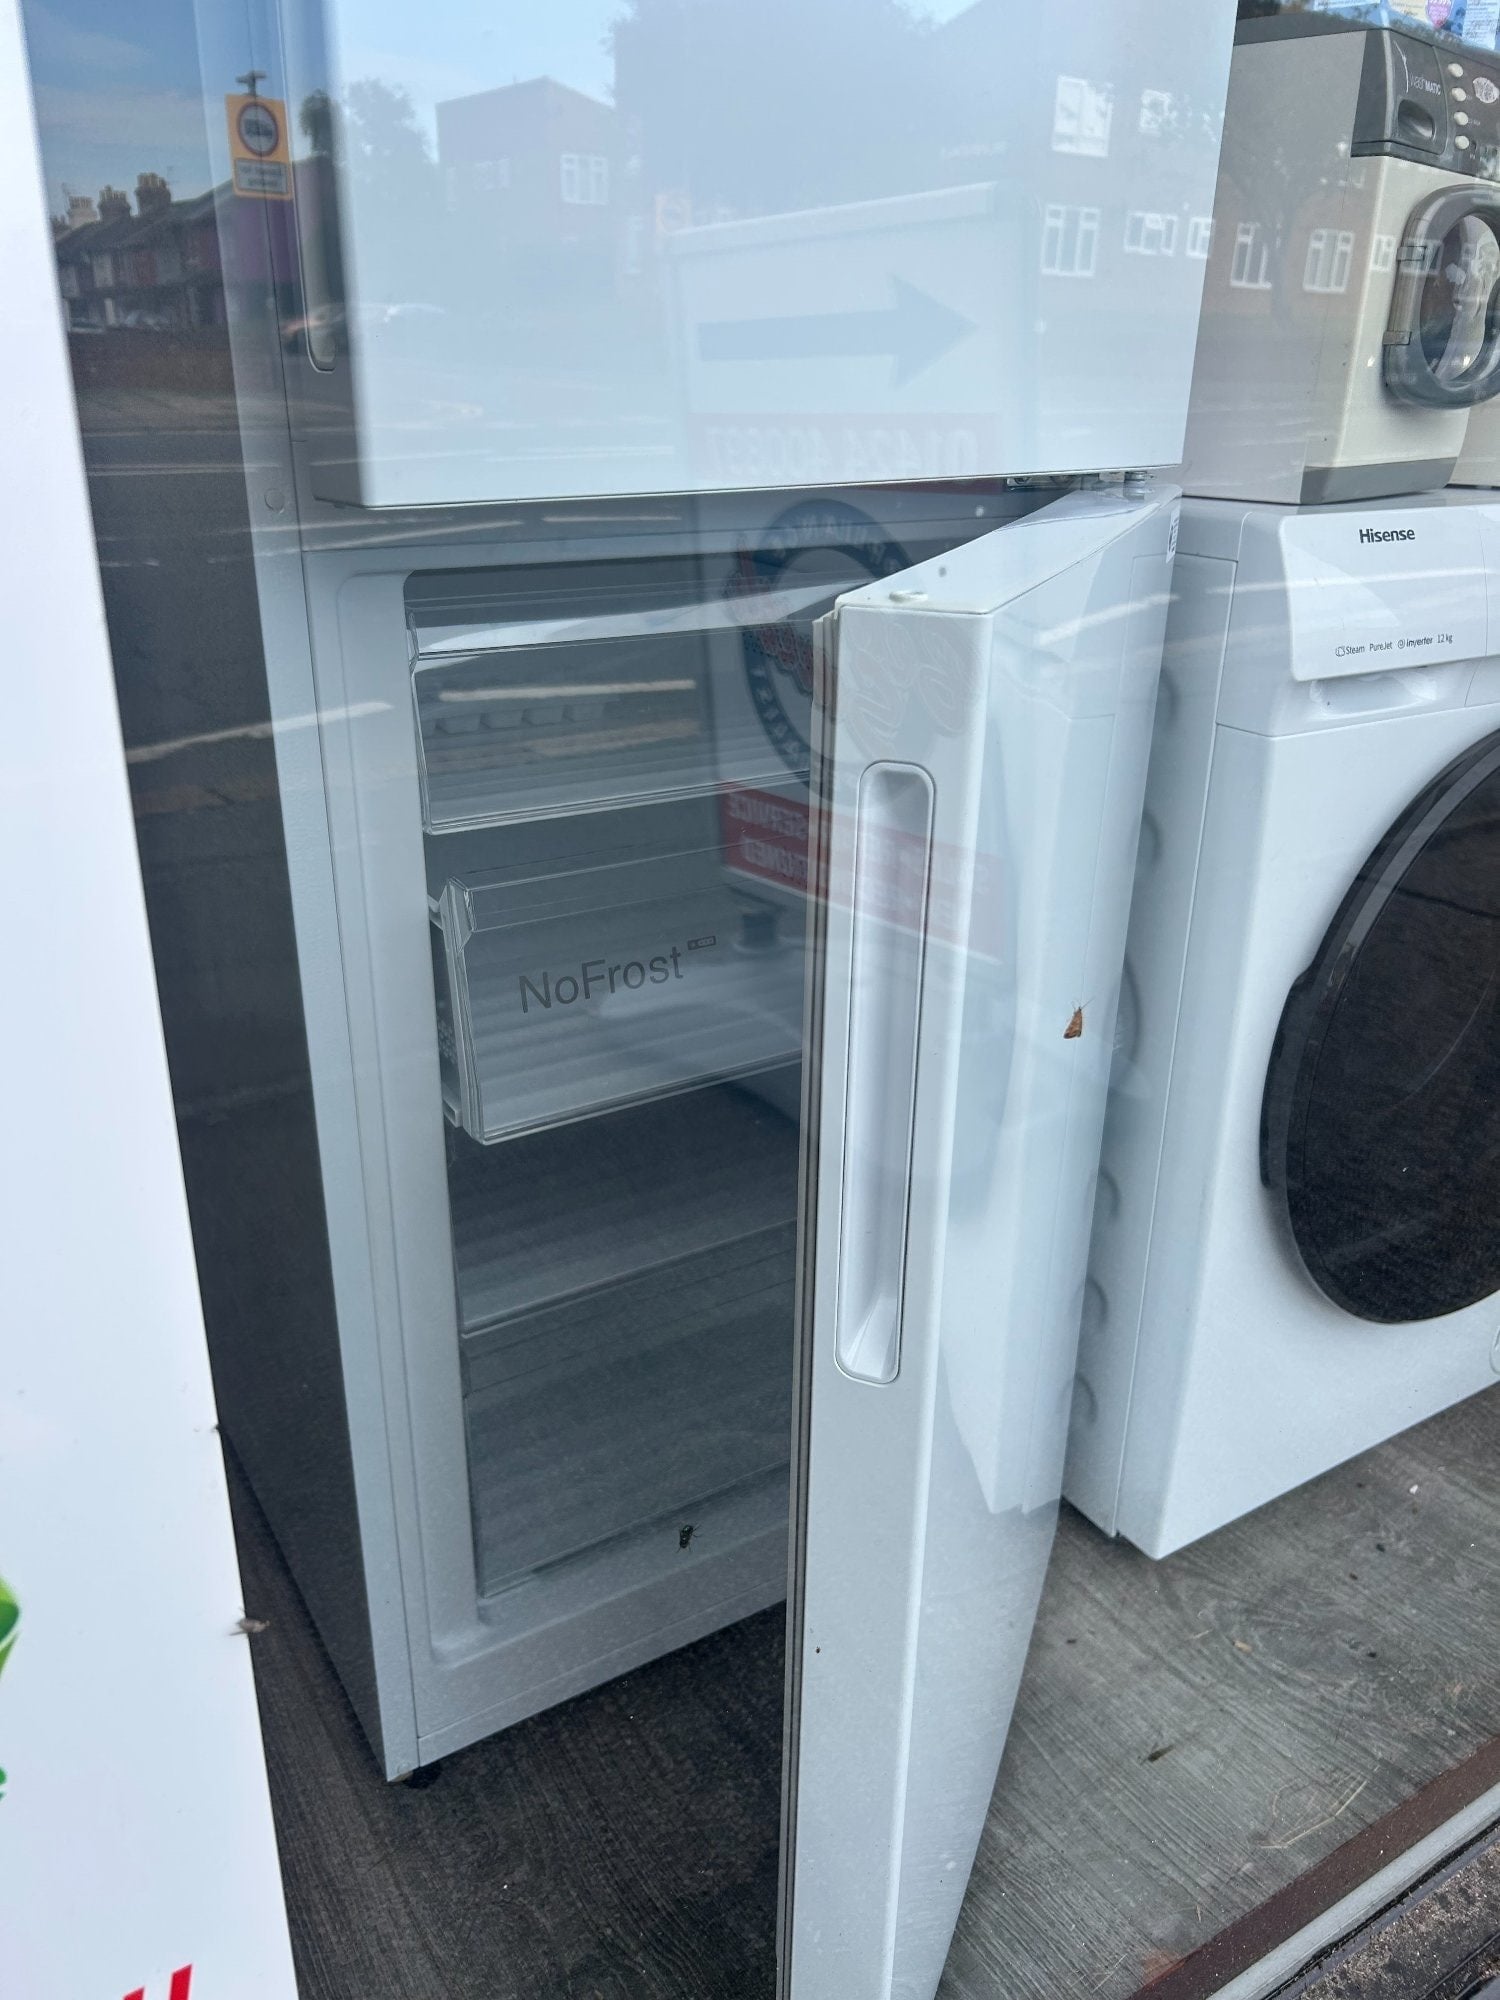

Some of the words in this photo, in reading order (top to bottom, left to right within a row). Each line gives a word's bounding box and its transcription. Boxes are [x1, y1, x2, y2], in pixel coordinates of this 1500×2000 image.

[1359, 528, 1416, 544] Hisense
[1345, 645, 1365, 655] Steam
[1369, 641, 1393, 652] PureJet
[518, 946, 684, 1014] NoFrost
